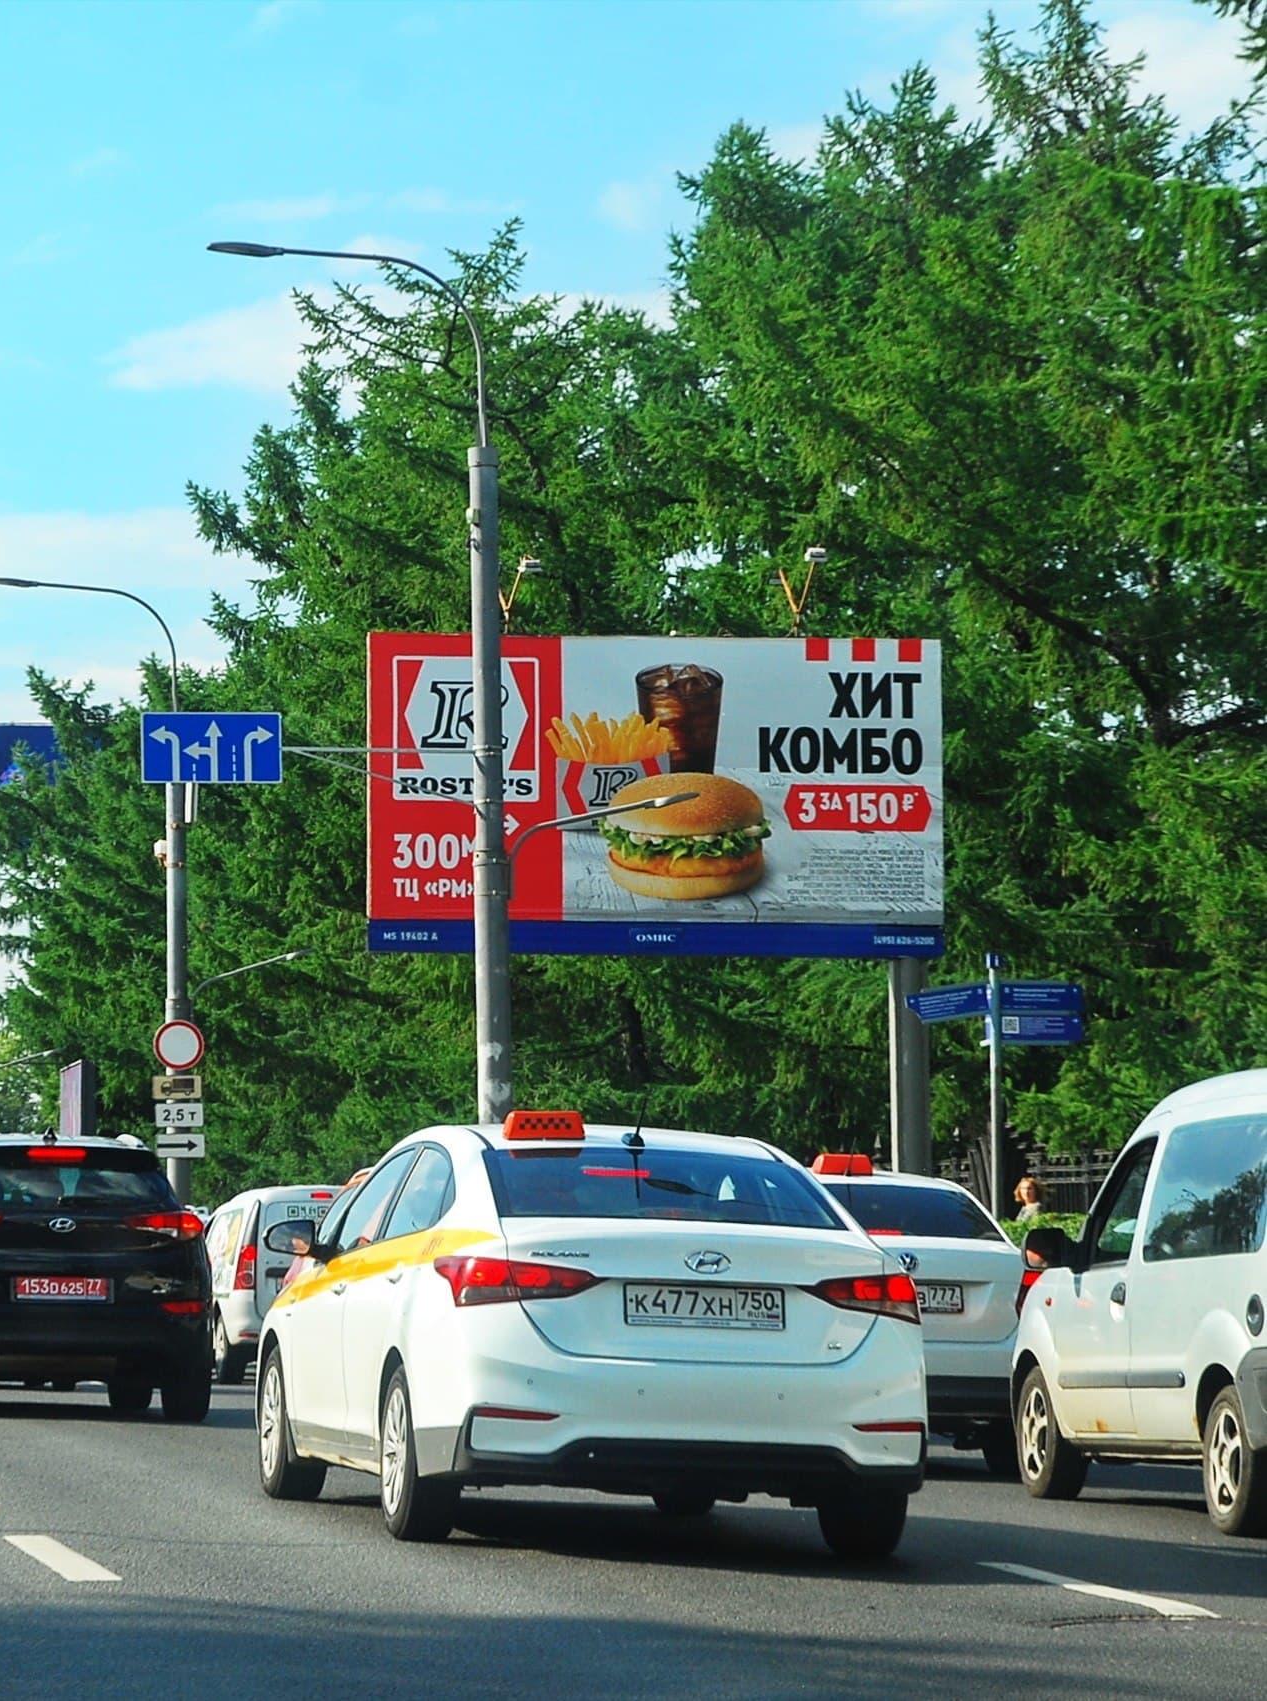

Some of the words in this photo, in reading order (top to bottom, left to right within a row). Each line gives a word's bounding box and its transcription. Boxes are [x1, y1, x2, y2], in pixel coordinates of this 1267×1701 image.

[828, 672, 922, 719] ХИТ
[758, 726, 923, 775] КОМБО
[399, 777, 533, 796] ROST'S
[393, 878, 420, 901] ТЦ
[162, 1109, 185, 1123] 2,5
[738, 1291, 775, 1311] 750
